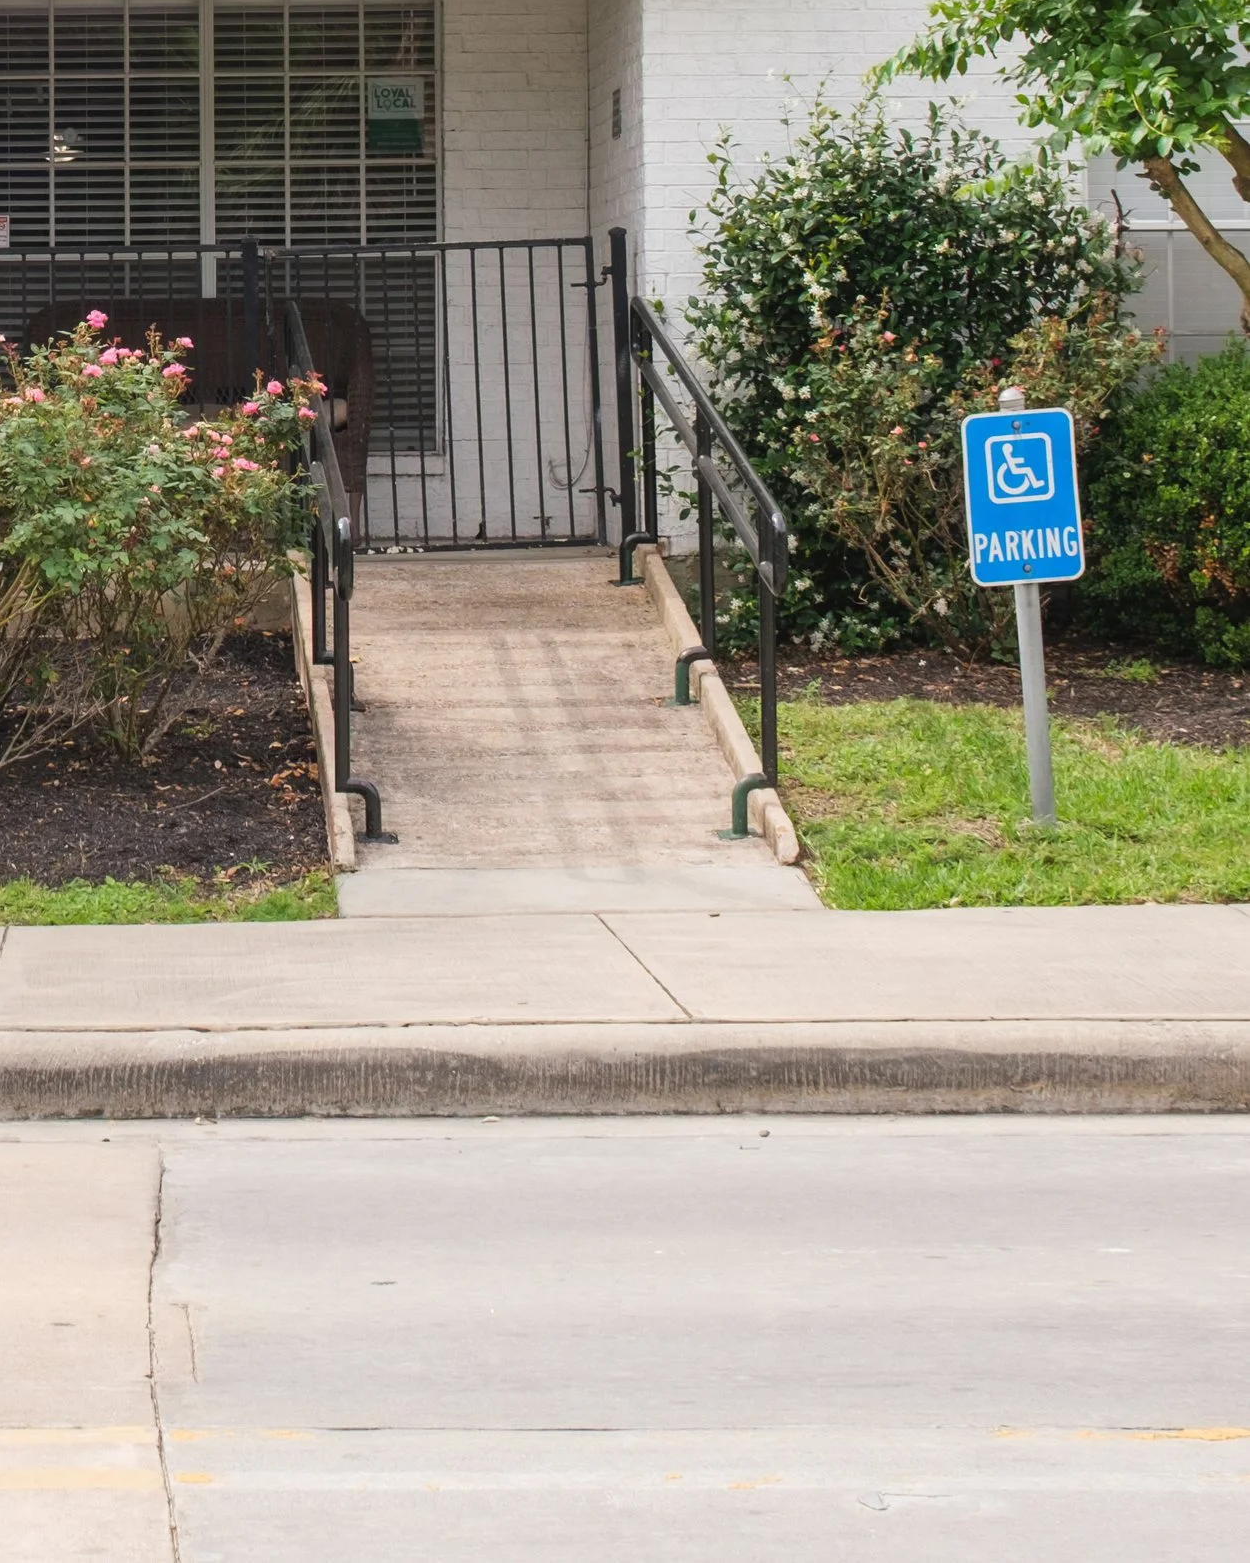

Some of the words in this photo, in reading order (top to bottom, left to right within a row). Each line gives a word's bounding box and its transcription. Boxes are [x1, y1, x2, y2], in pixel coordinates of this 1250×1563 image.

[374, 87, 412, 98] LOYAL
[376, 98, 417, 110] LOCAL
[974, 526, 1078, 563] PARKING
